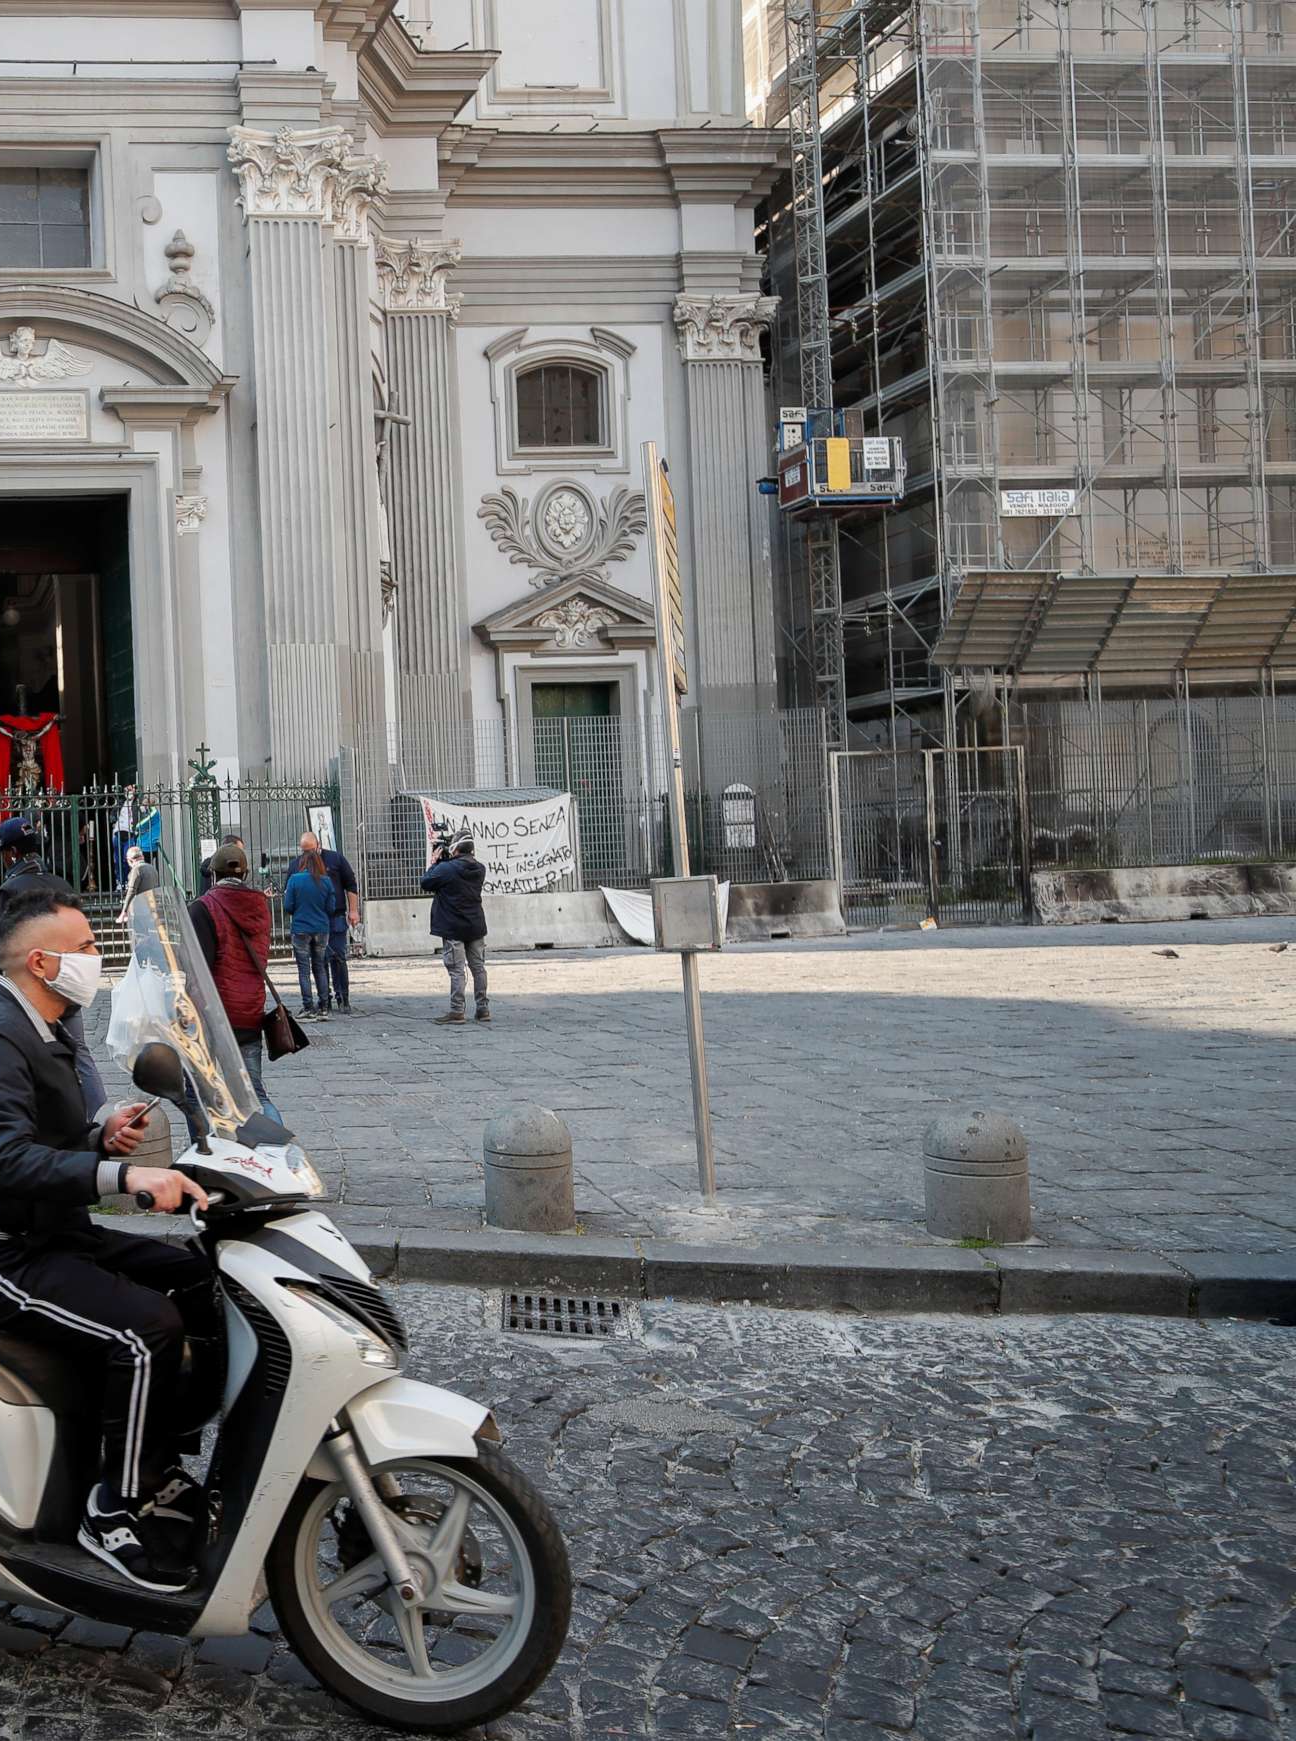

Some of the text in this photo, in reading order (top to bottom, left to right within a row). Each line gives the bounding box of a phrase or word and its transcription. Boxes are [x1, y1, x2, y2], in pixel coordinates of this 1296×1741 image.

[1038, 490, 1070, 503] Italia
[461, 814, 509, 838] ANNO
[487, 842, 540, 859] TE...
[488, 845, 572, 875] HAI INSEGNATO
[483, 867, 571, 894] OMBATTERE
